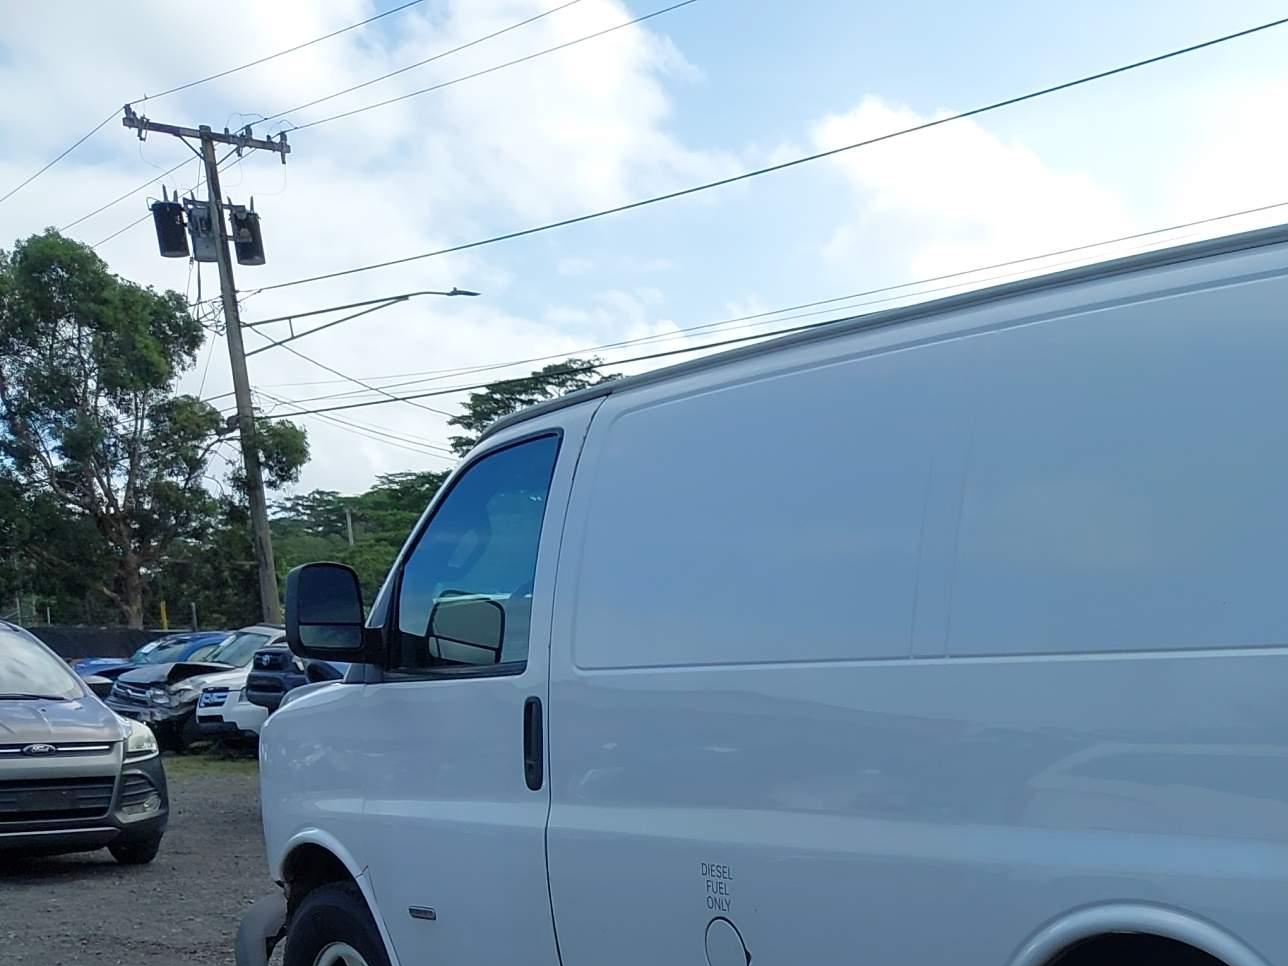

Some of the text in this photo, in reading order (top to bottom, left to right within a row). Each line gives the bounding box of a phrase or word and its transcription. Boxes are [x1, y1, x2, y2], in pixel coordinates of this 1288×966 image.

[701, 862, 733, 880] DIESEL
[706, 879, 730, 896] FUEL
[706, 896, 731, 912] ONLY
